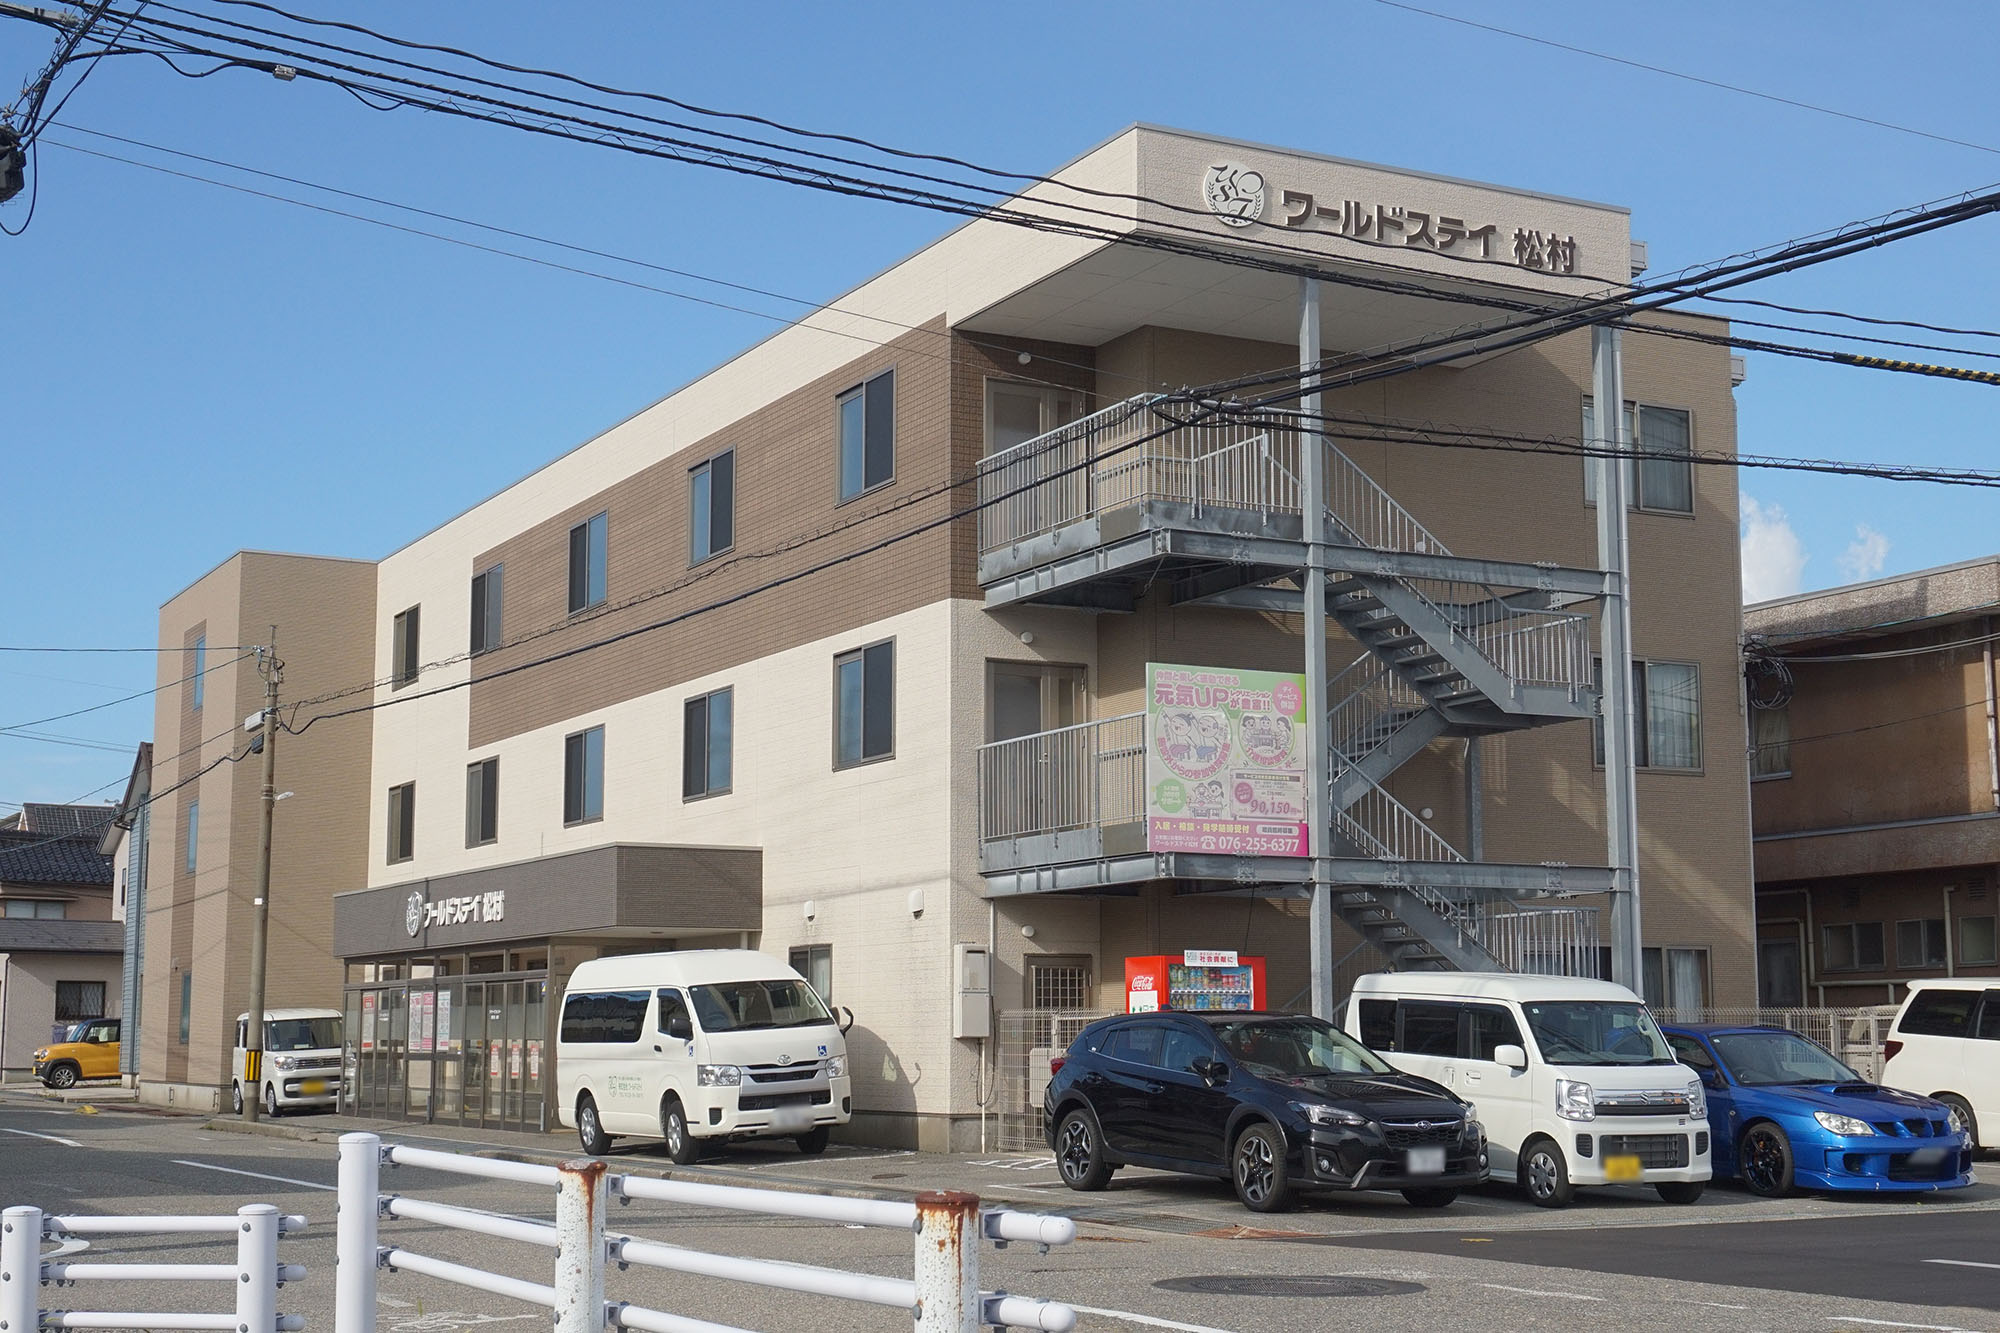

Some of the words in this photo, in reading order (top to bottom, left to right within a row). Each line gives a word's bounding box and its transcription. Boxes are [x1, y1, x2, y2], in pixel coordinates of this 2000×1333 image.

[1282, 190, 1497, 258] ワールドステイ
[1512, 228, 1577, 273] 松村
[1155, 683, 1229, 708] 元気UP
[1218, 836, 1300, 852] 076-255-6377
[424, 895, 482, 928] ワールドステイ
[483, 890, 505, 922] 松村
